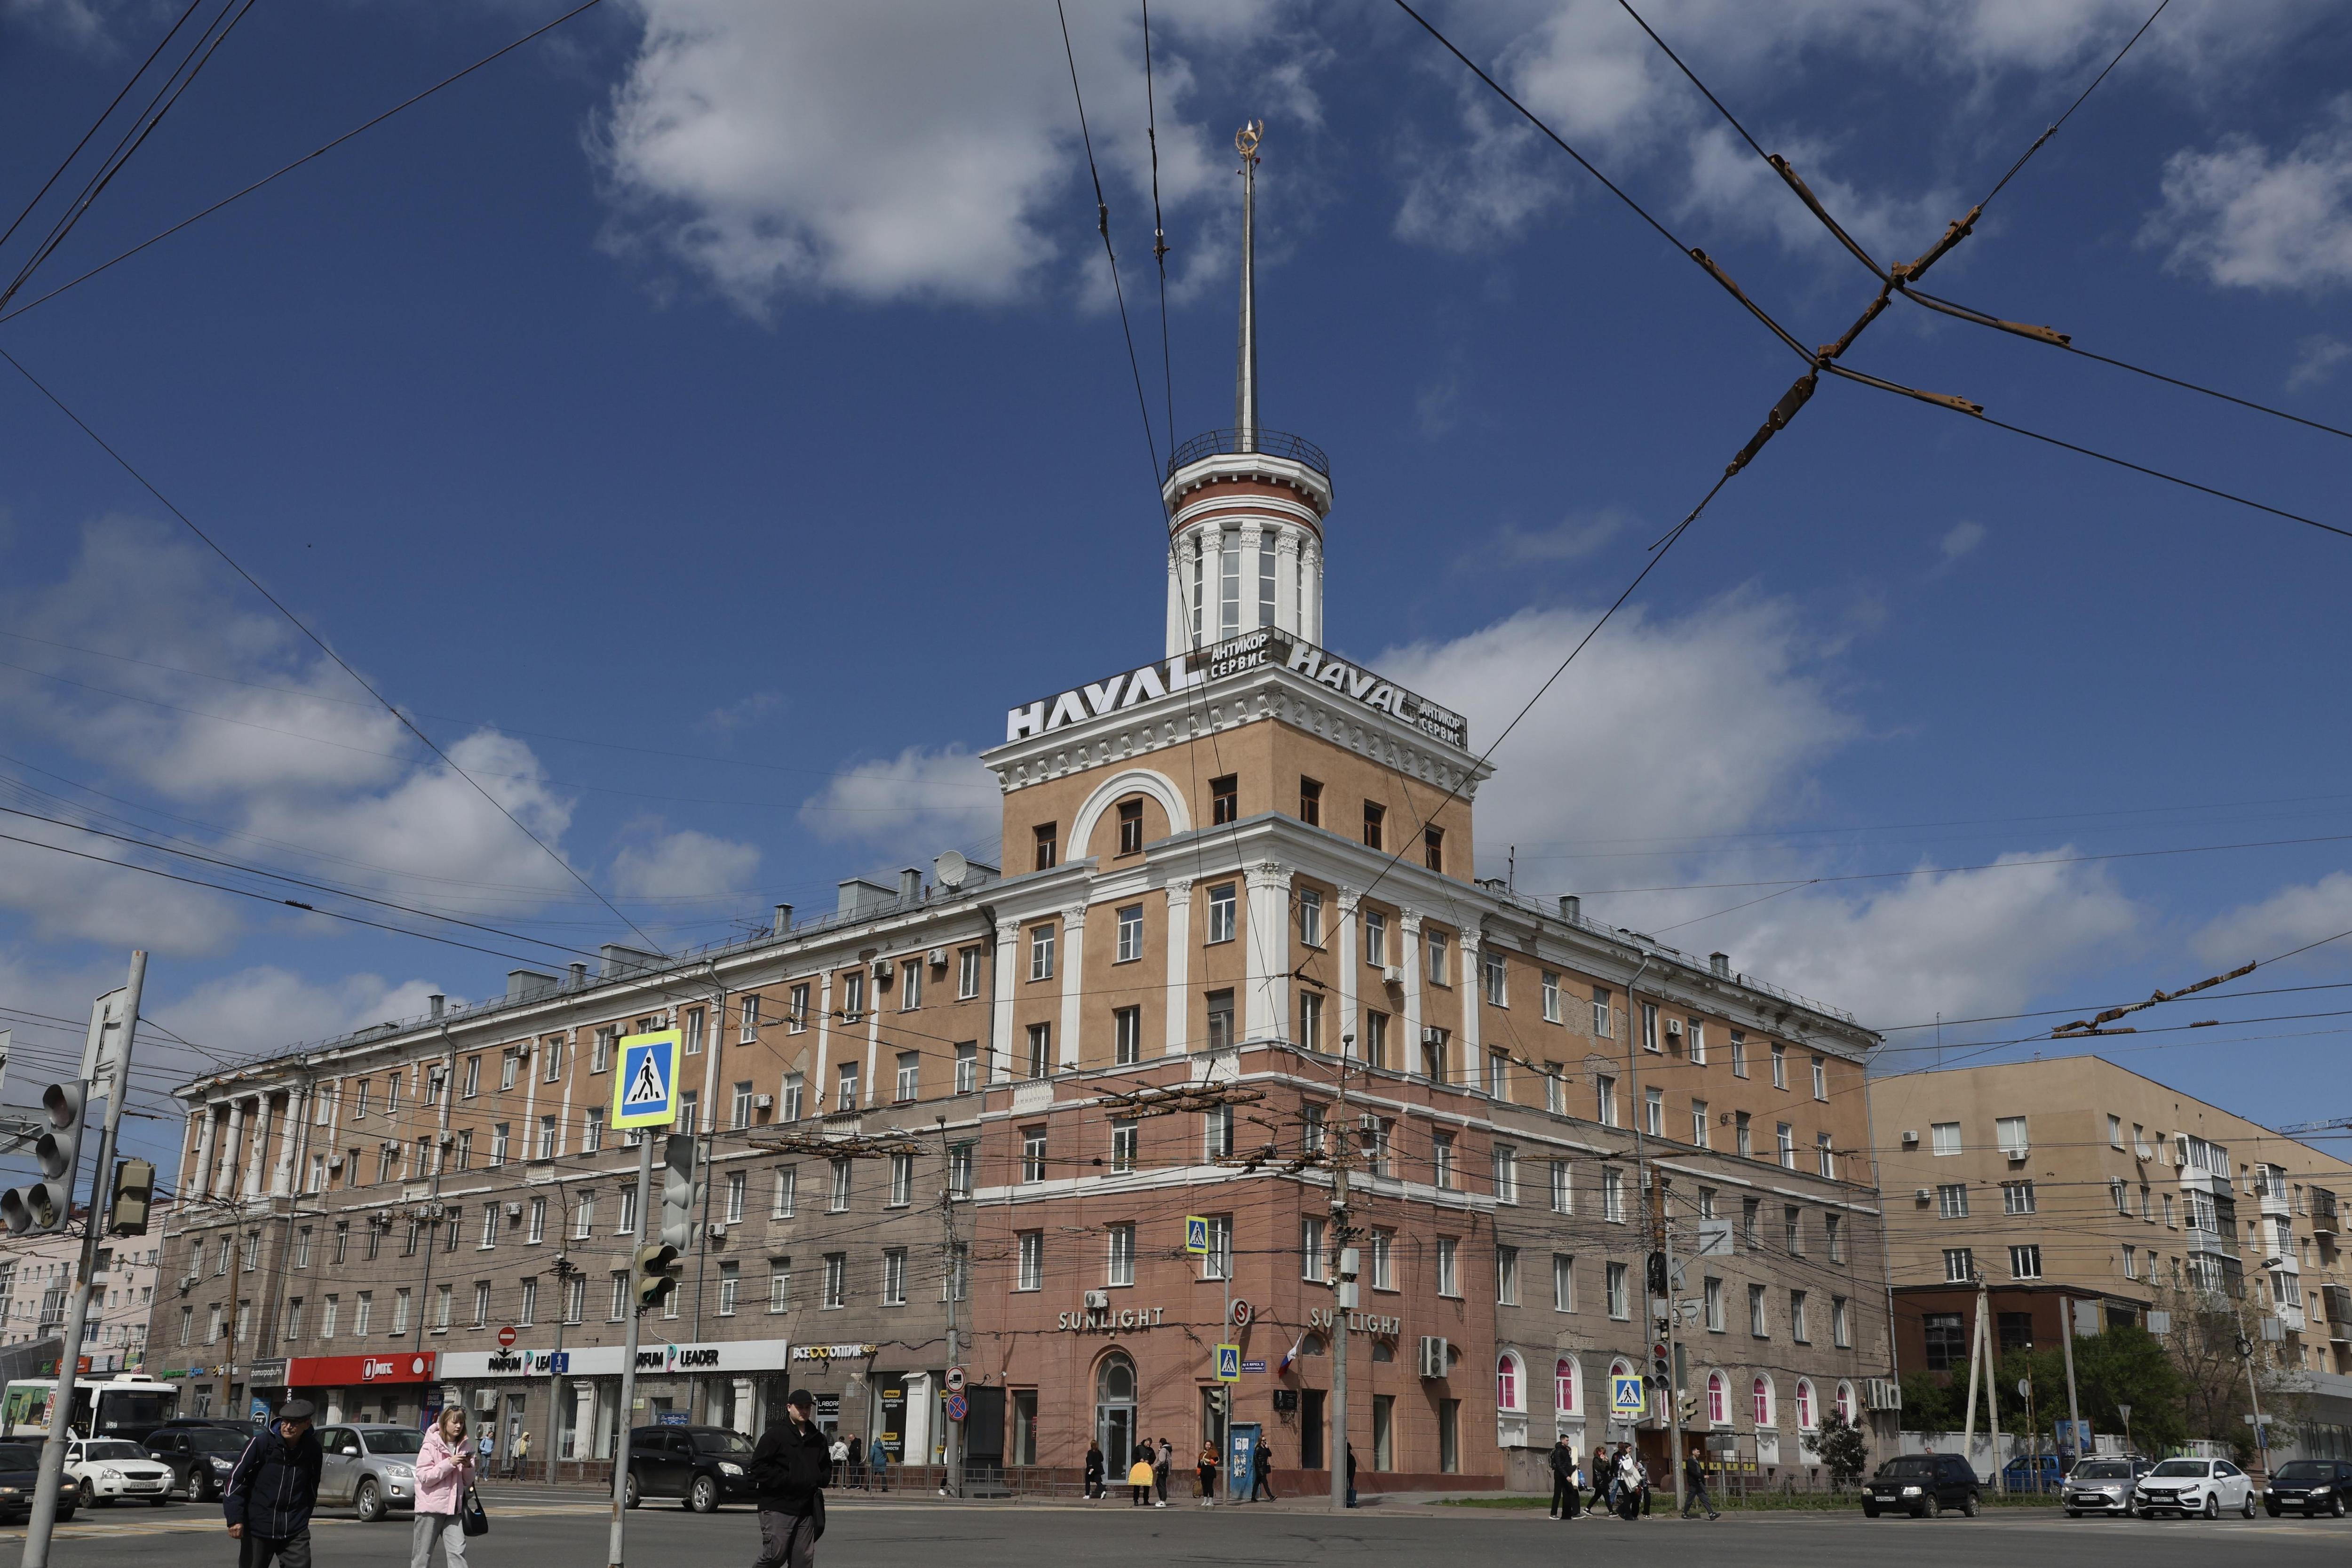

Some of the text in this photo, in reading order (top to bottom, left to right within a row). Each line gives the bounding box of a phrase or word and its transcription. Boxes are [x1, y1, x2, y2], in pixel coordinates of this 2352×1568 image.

[1211, 633, 1267, 662] АНТИКОР
[1211, 650, 1266, 678] СЕРВИС
[1286, 643, 1414, 724] HAVAL
[1007, 654, 1208, 742] HAVAL
[1422, 703, 1460, 730] АНТИКОР
[1422, 718, 1460, 746] СЕРВИС
[1058, 1307, 1163, 1329] SUNLIGHT
[1237, 1304, 1245, 1321] S
[1311, 1308, 1400, 1334] SULIGHT
[680, 1350, 718, 1364] LEADER
[794, 1347, 810, 1359] ВСЕ
[375, 1363, 393, 1375] МТС
